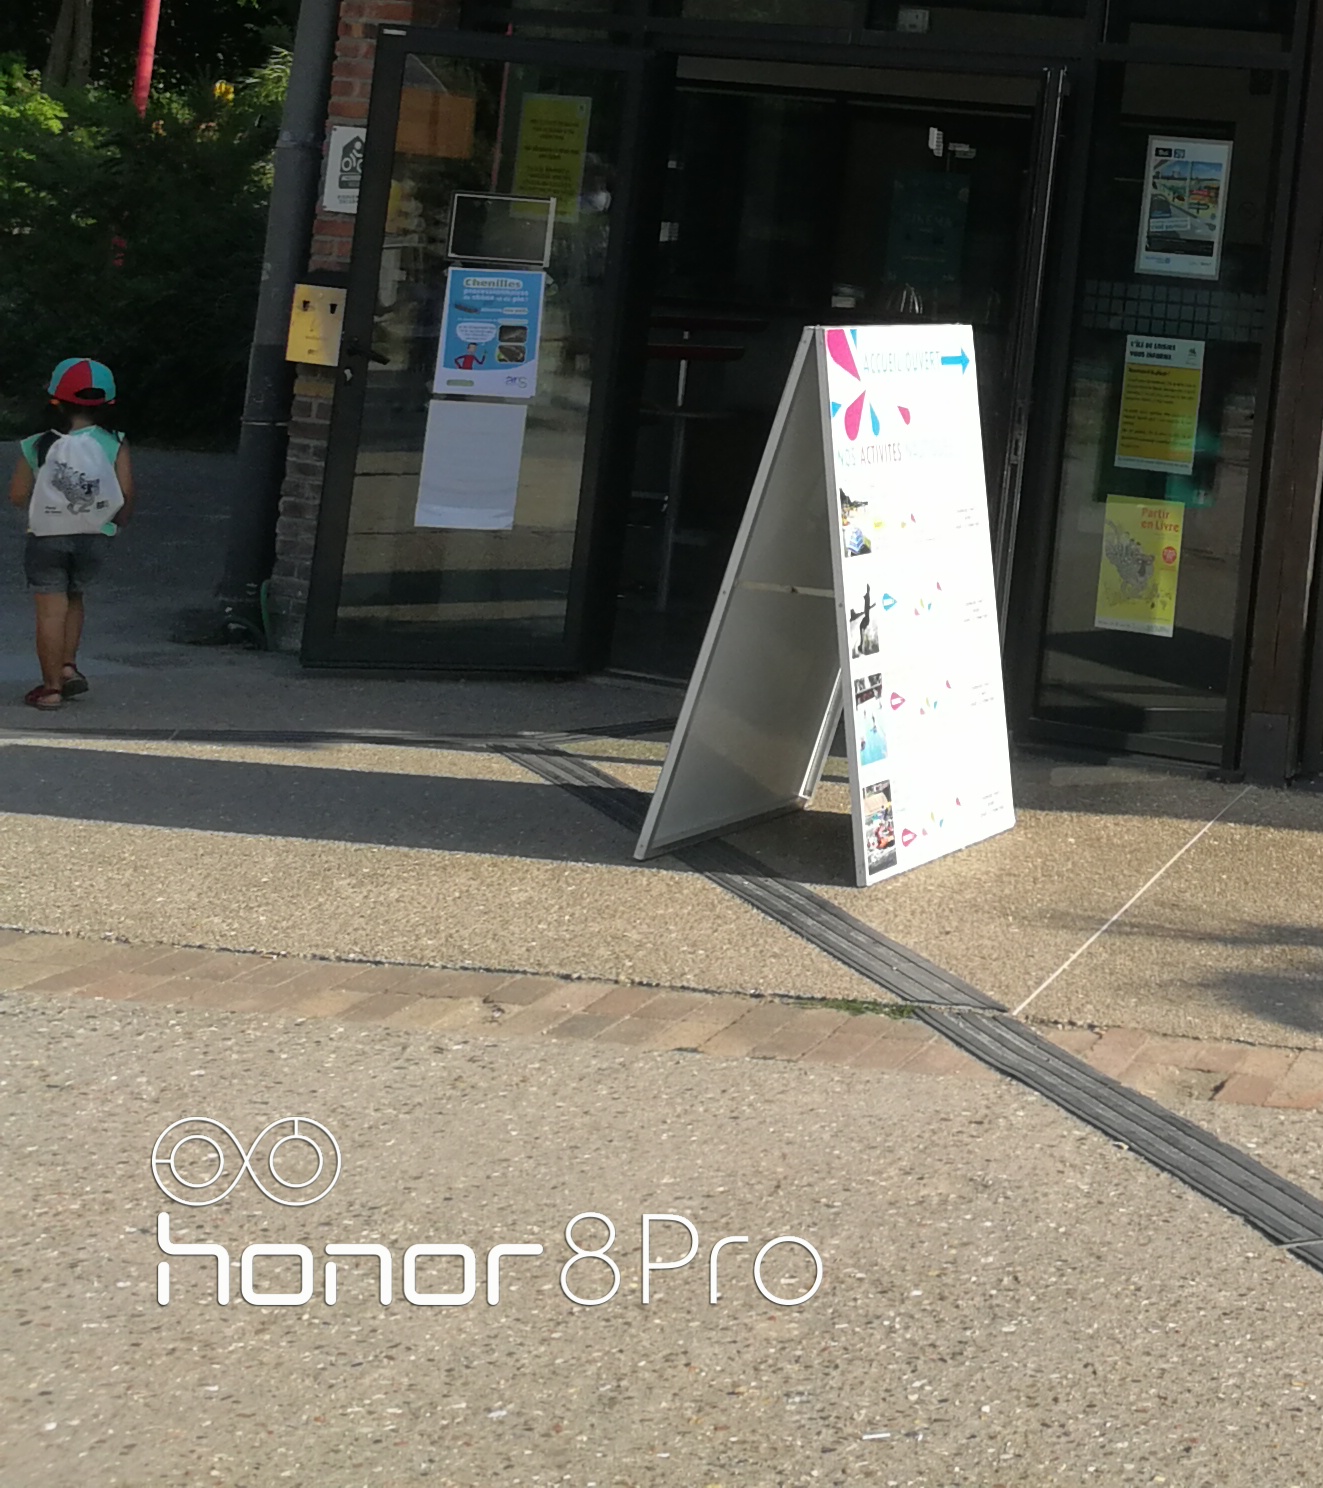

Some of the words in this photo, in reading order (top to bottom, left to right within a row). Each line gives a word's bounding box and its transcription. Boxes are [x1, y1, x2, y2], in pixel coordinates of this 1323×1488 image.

[465, 278, 521, 289] Chenilles
[860, 442, 902, 465] ACTIVITES
[1142, 507, 1170, 520] Partir
[1141, 520, 1154, 529] en
[1155, 519, 1180, 533] Livre
